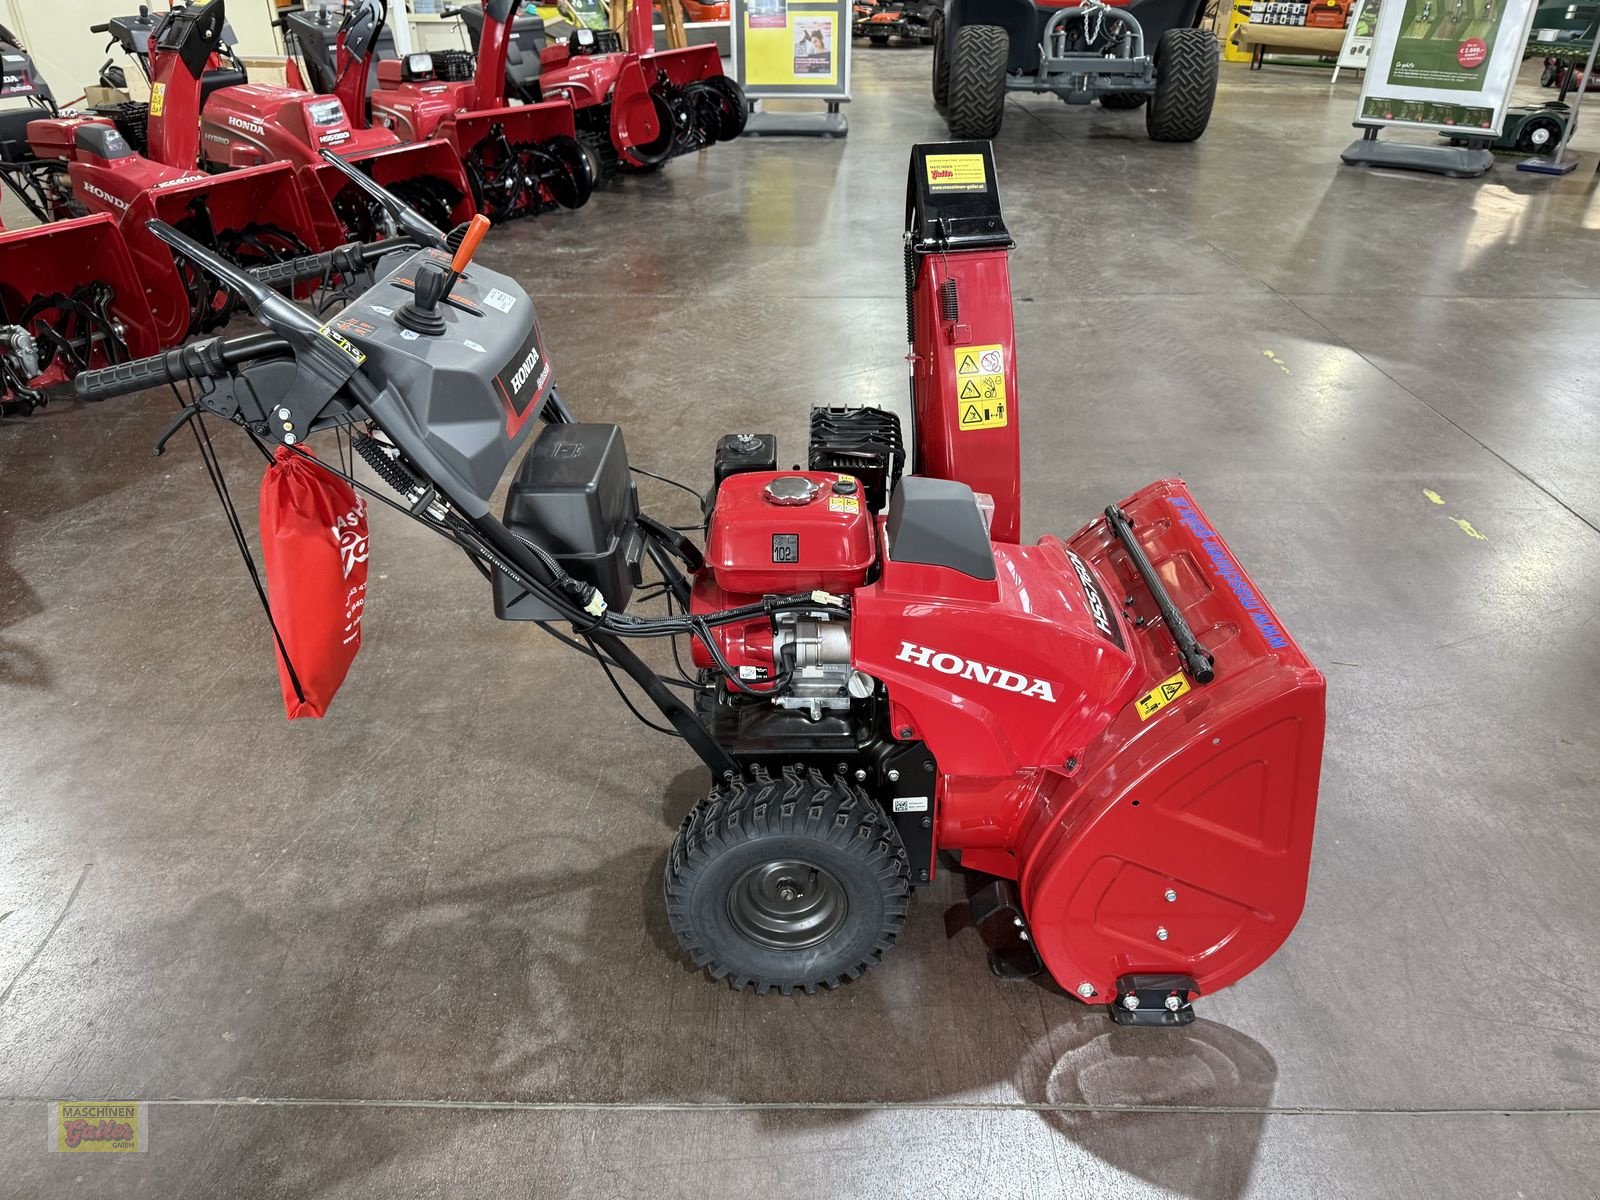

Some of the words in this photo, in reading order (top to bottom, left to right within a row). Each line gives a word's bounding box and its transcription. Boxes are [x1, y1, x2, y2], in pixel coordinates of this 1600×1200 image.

[228, 116, 265, 136] HONDA
[205, 133, 230, 145] HYBRID
[510, 347, 540, 395] HONDA
[775, 546, 791, 561] 102
[895, 641, 1057, 702] HONDA
